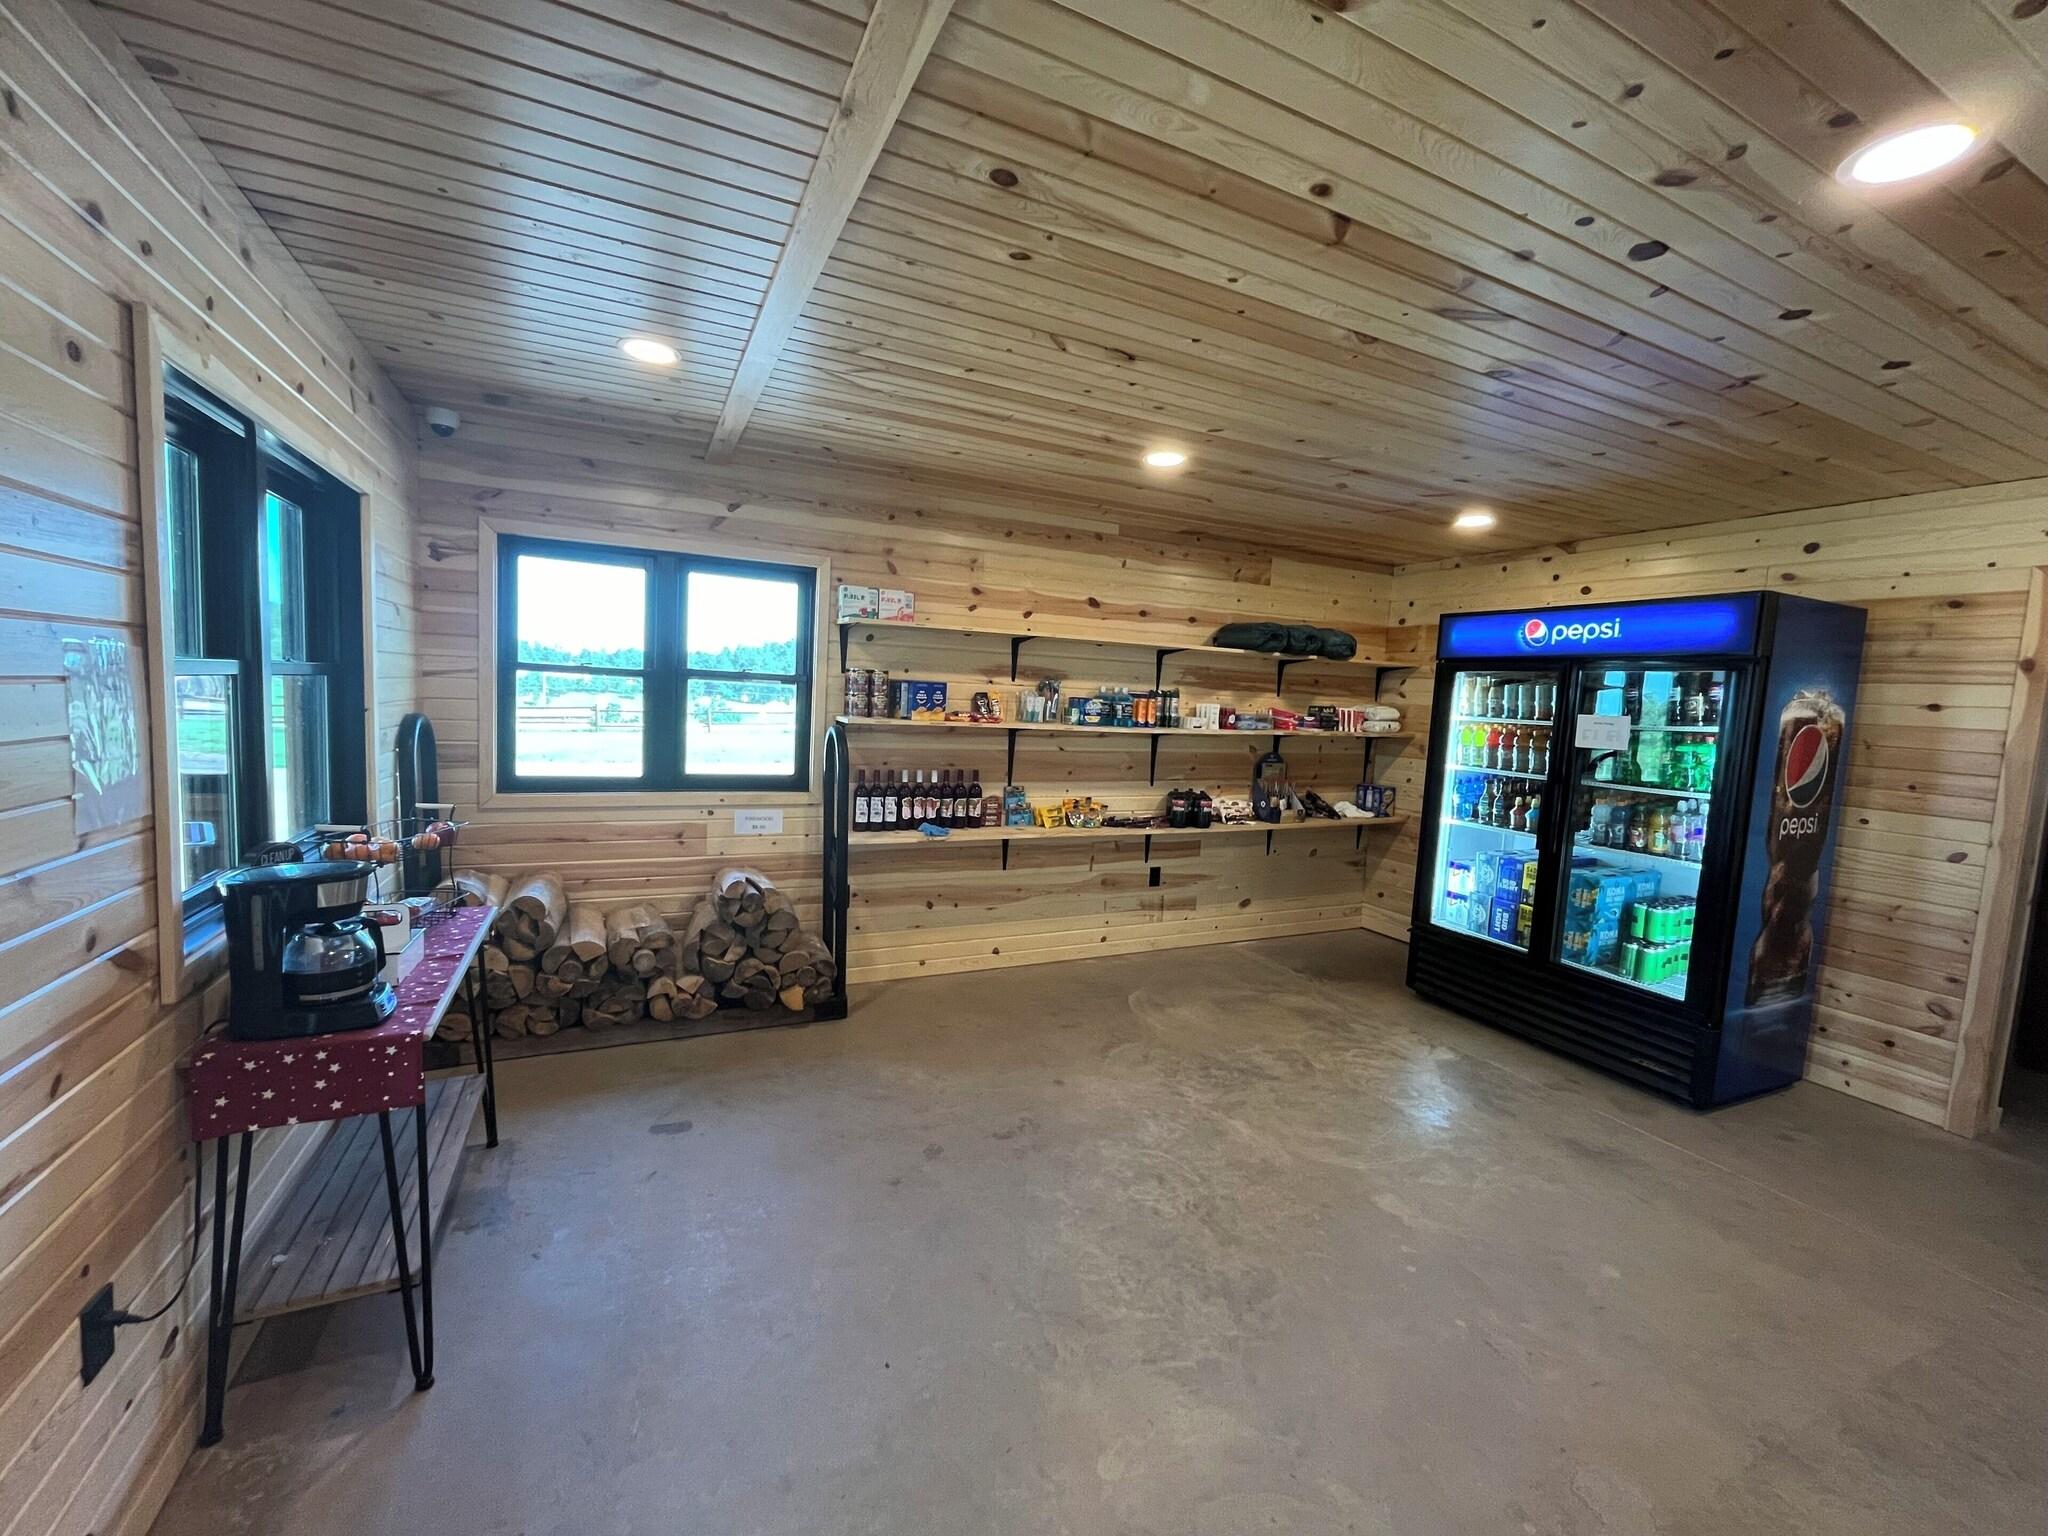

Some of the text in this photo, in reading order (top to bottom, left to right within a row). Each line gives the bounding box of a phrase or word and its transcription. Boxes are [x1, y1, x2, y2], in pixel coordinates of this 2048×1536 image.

[1551, 617, 1620, 645] pepsi
[1778, 812, 1819, 841] pepsi
[1501, 912, 1509, 931] BUD
